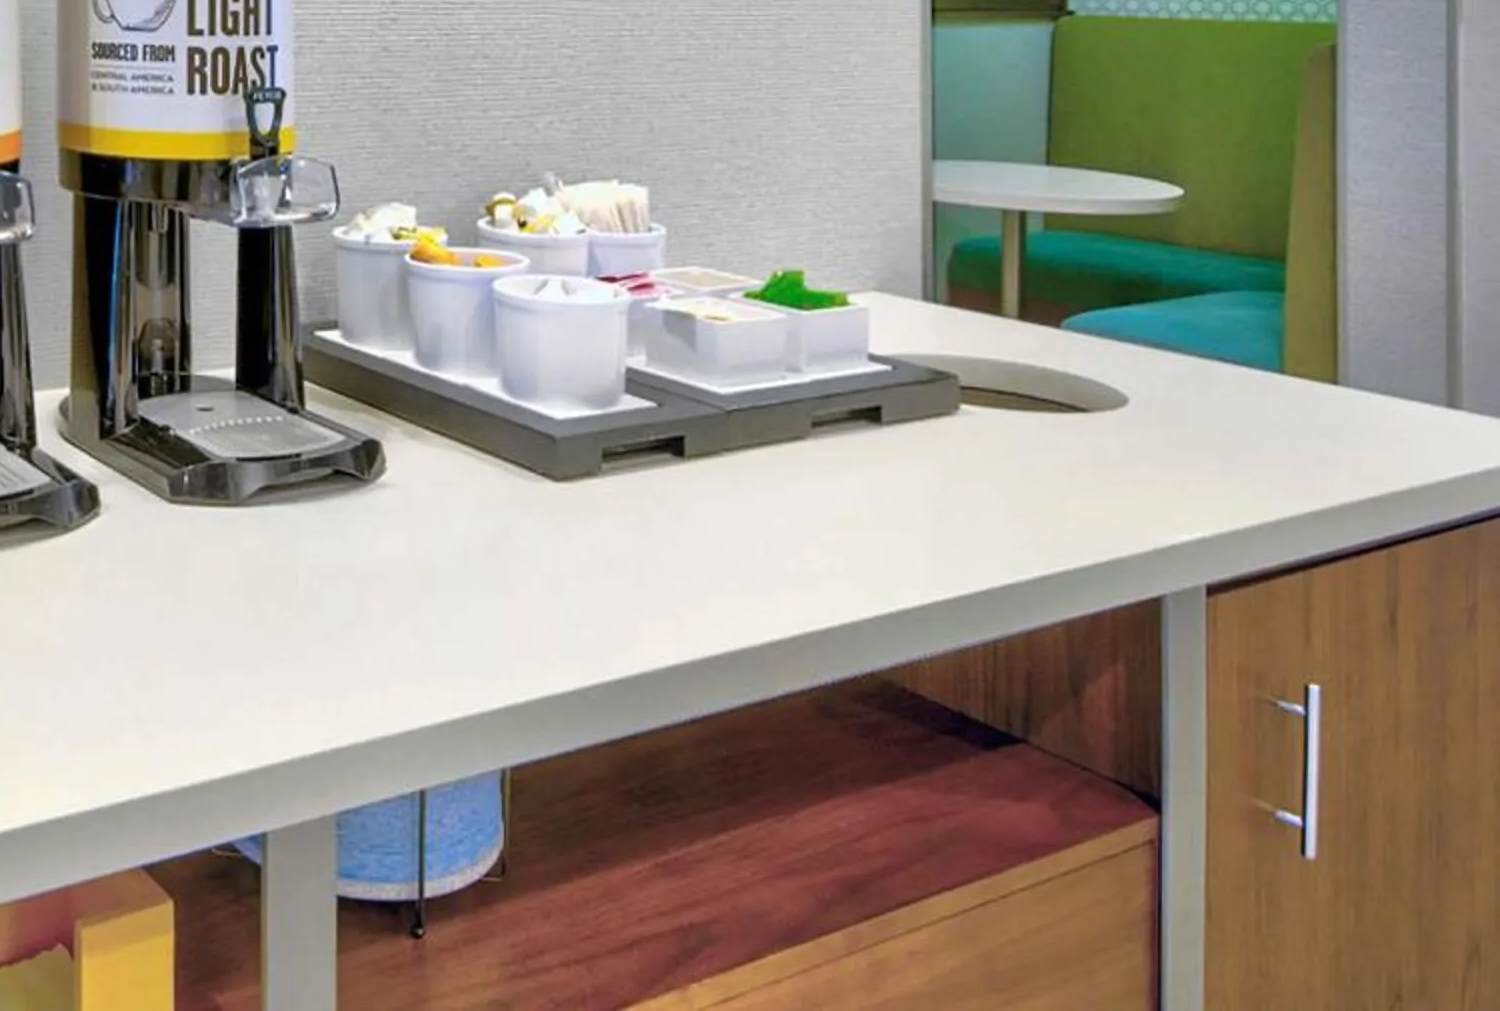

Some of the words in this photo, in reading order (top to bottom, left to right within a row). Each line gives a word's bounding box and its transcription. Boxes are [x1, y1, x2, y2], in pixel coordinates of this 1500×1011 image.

[92, 42, 138, 61] SOURCED
[143, 45, 175, 62] FROM
[187, 45, 278, 95] ROAST
[131, 74, 173, 83] AMERICA
[130, 86, 174, 95] AMERICA
